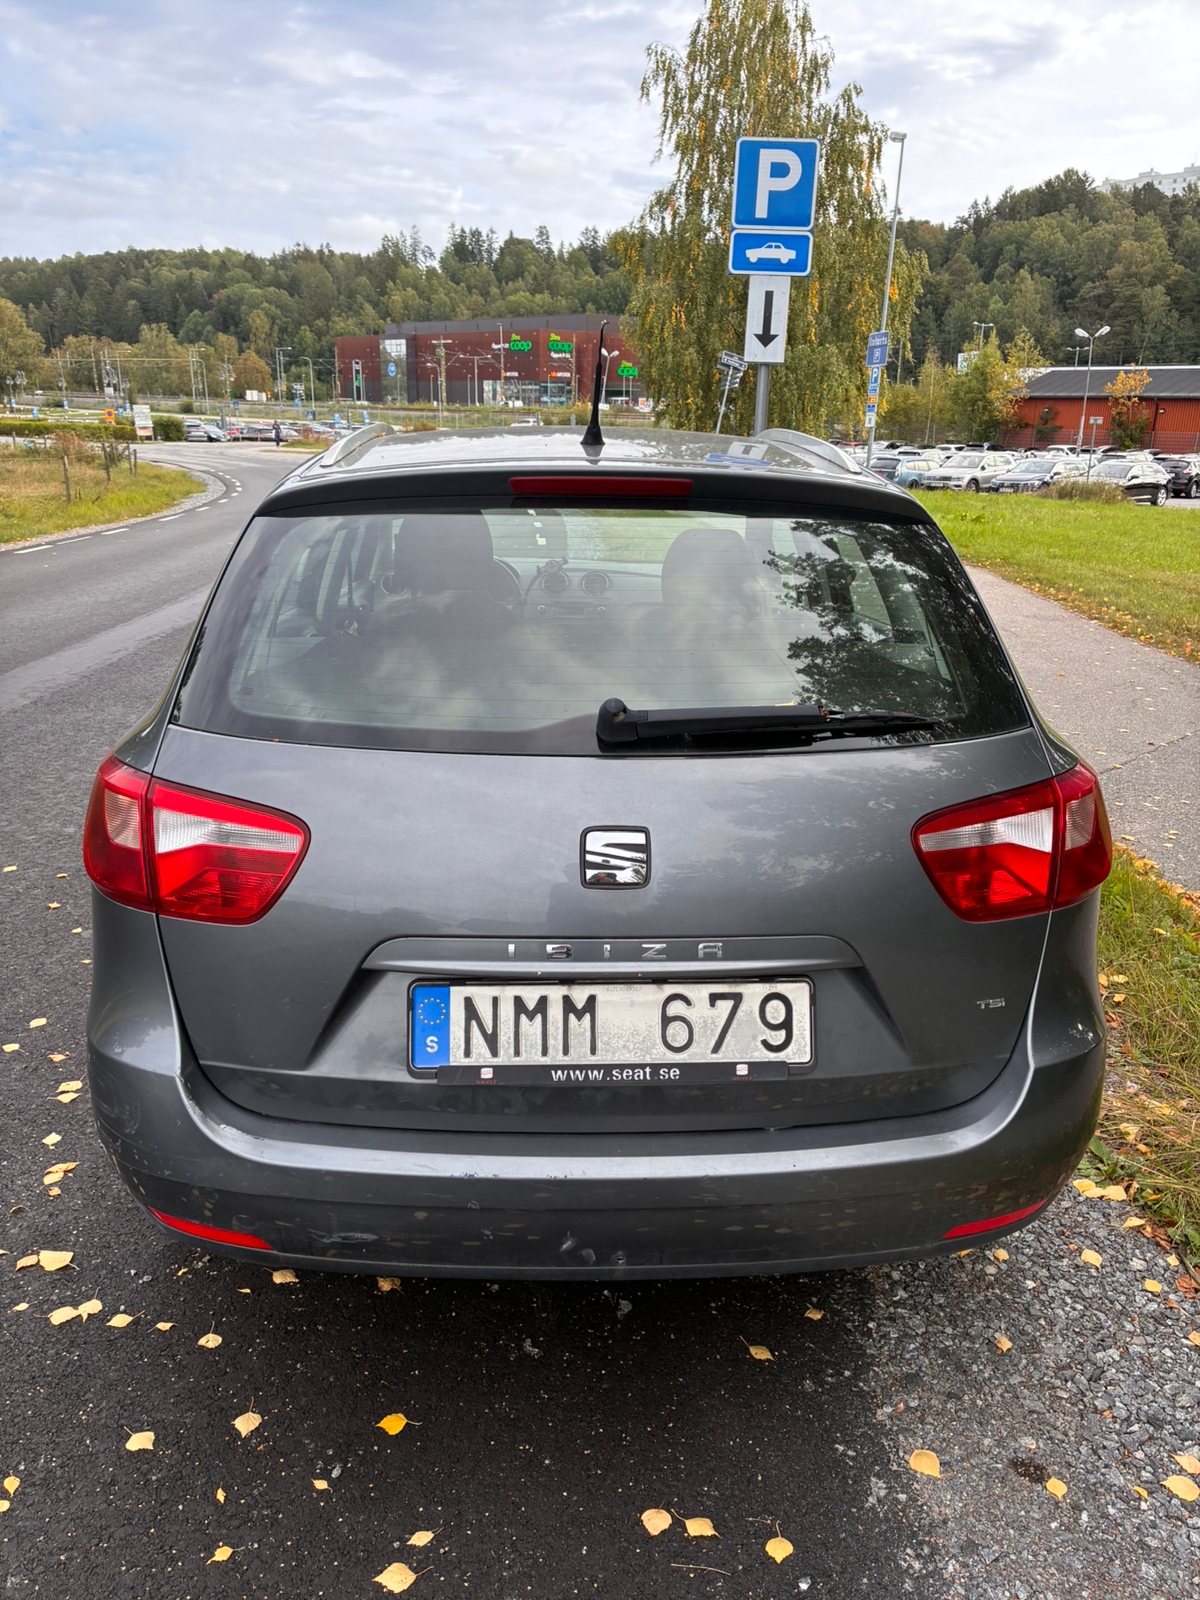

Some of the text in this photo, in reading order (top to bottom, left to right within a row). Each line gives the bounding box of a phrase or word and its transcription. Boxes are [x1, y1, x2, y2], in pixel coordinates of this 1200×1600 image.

[755, 148, 802, 218] P
[510, 341, 532, 352] coop
[548, 341, 573, 353] coop
[869, 335, 888, 347] Infarts
[872, 368, 878, 382] P
[507, 942, 723, 960] IBIZA
[463, 992, 793, 1058] NMM 679
[425, 1036, 439, 1053] S
[551, 1066, 680, 1081] www.seat.se
